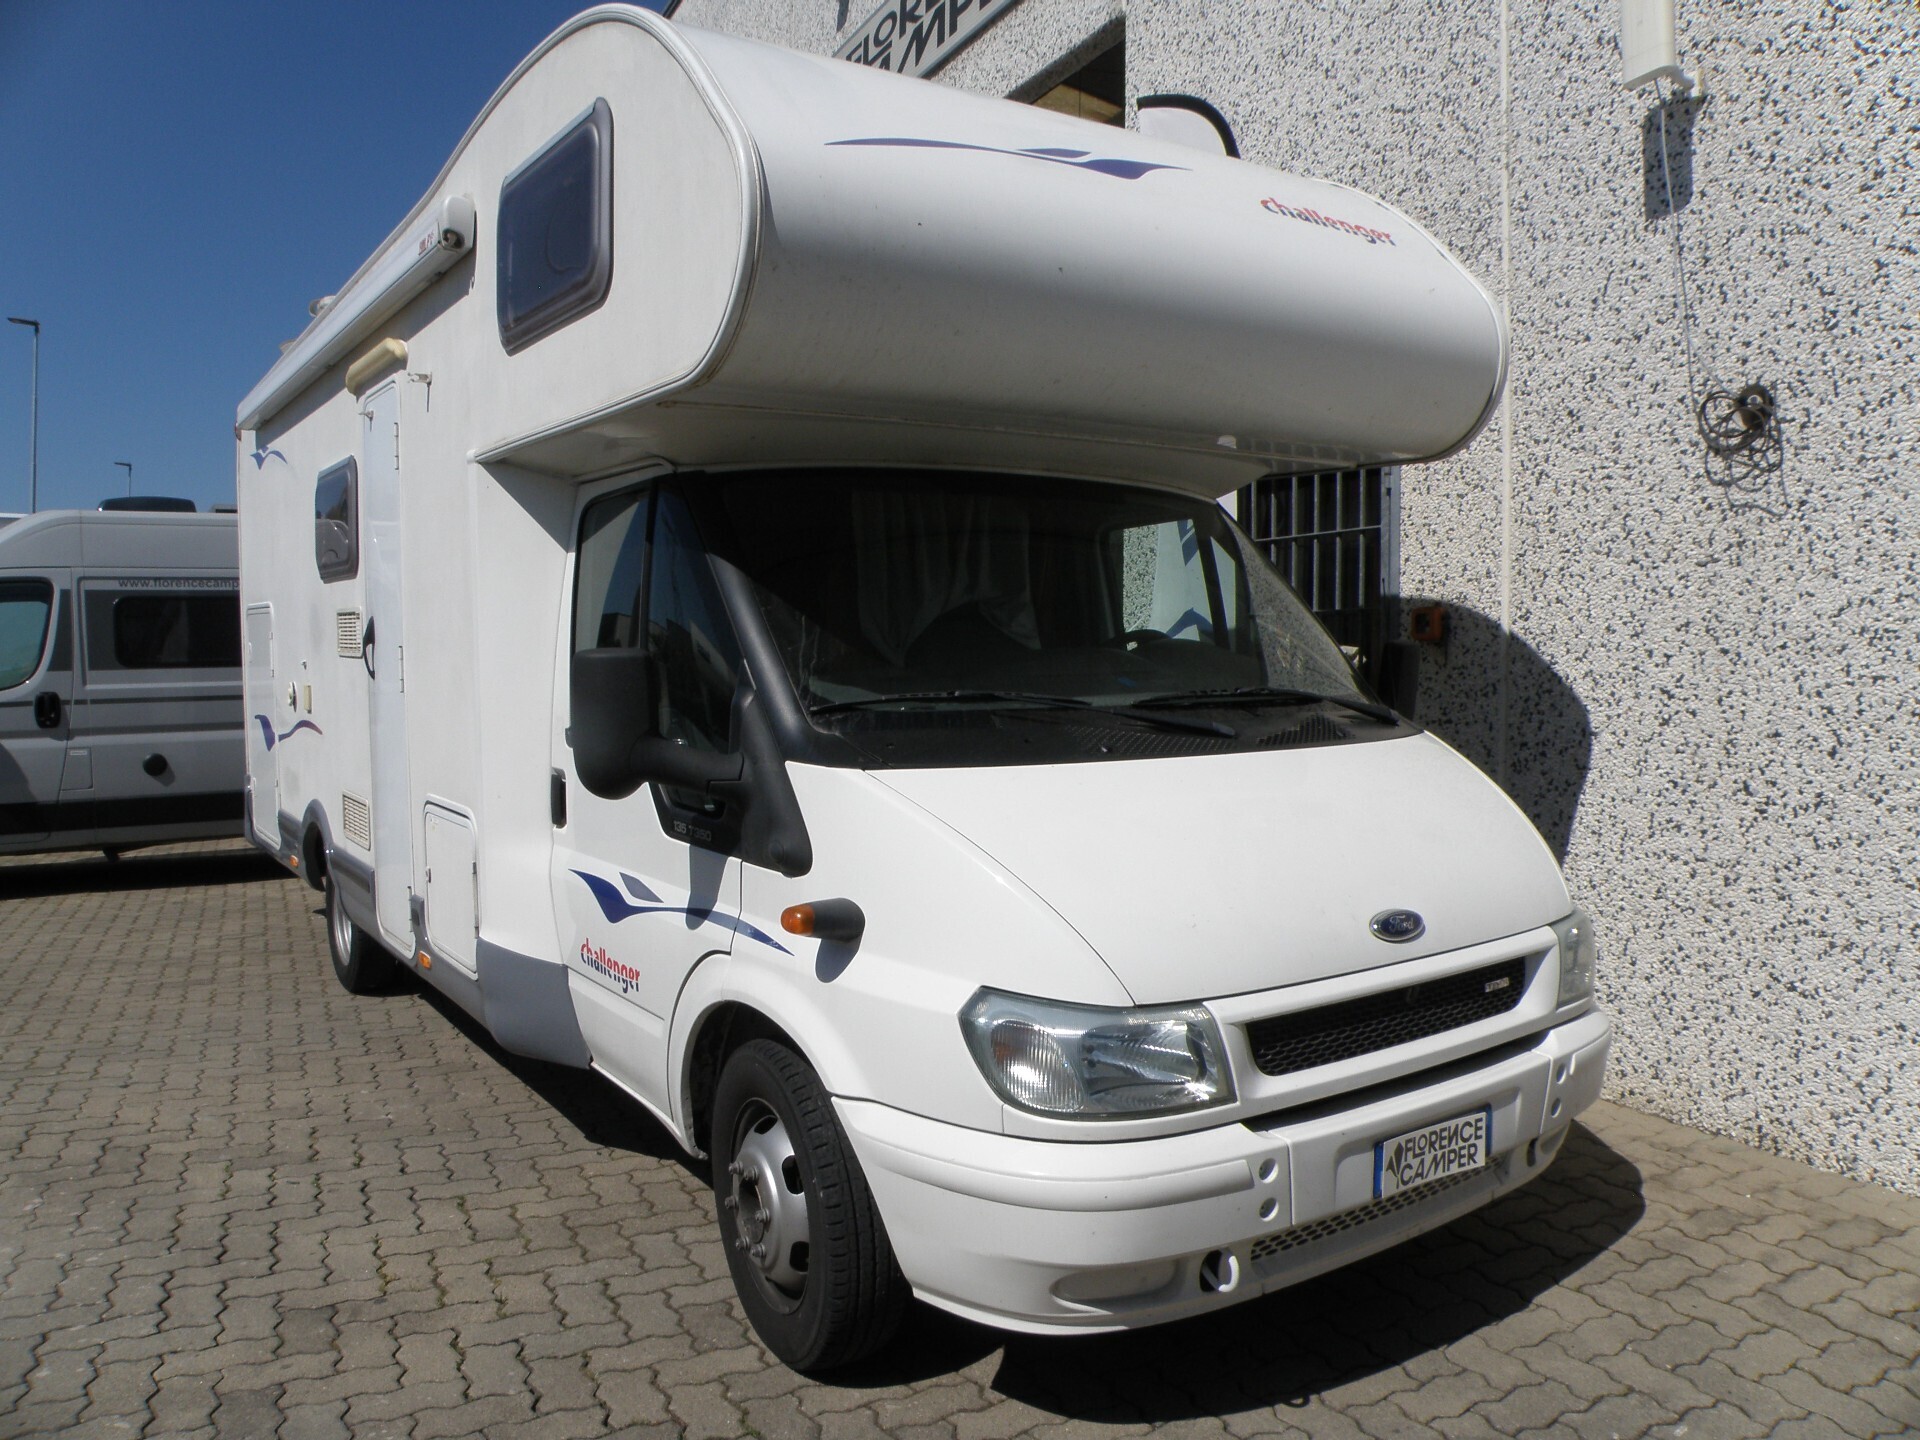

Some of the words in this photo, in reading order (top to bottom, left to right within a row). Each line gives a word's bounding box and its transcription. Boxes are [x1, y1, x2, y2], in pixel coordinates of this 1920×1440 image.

[1260, 197, 1397, 247] challenger
[1389, 914, 1414, 932] Ford
[580, 937, 641, 994] challenger
[1404, 1117, 1484, 1162] FLORENCE
[1400, 1142, 1478, 1186] CAMPER
